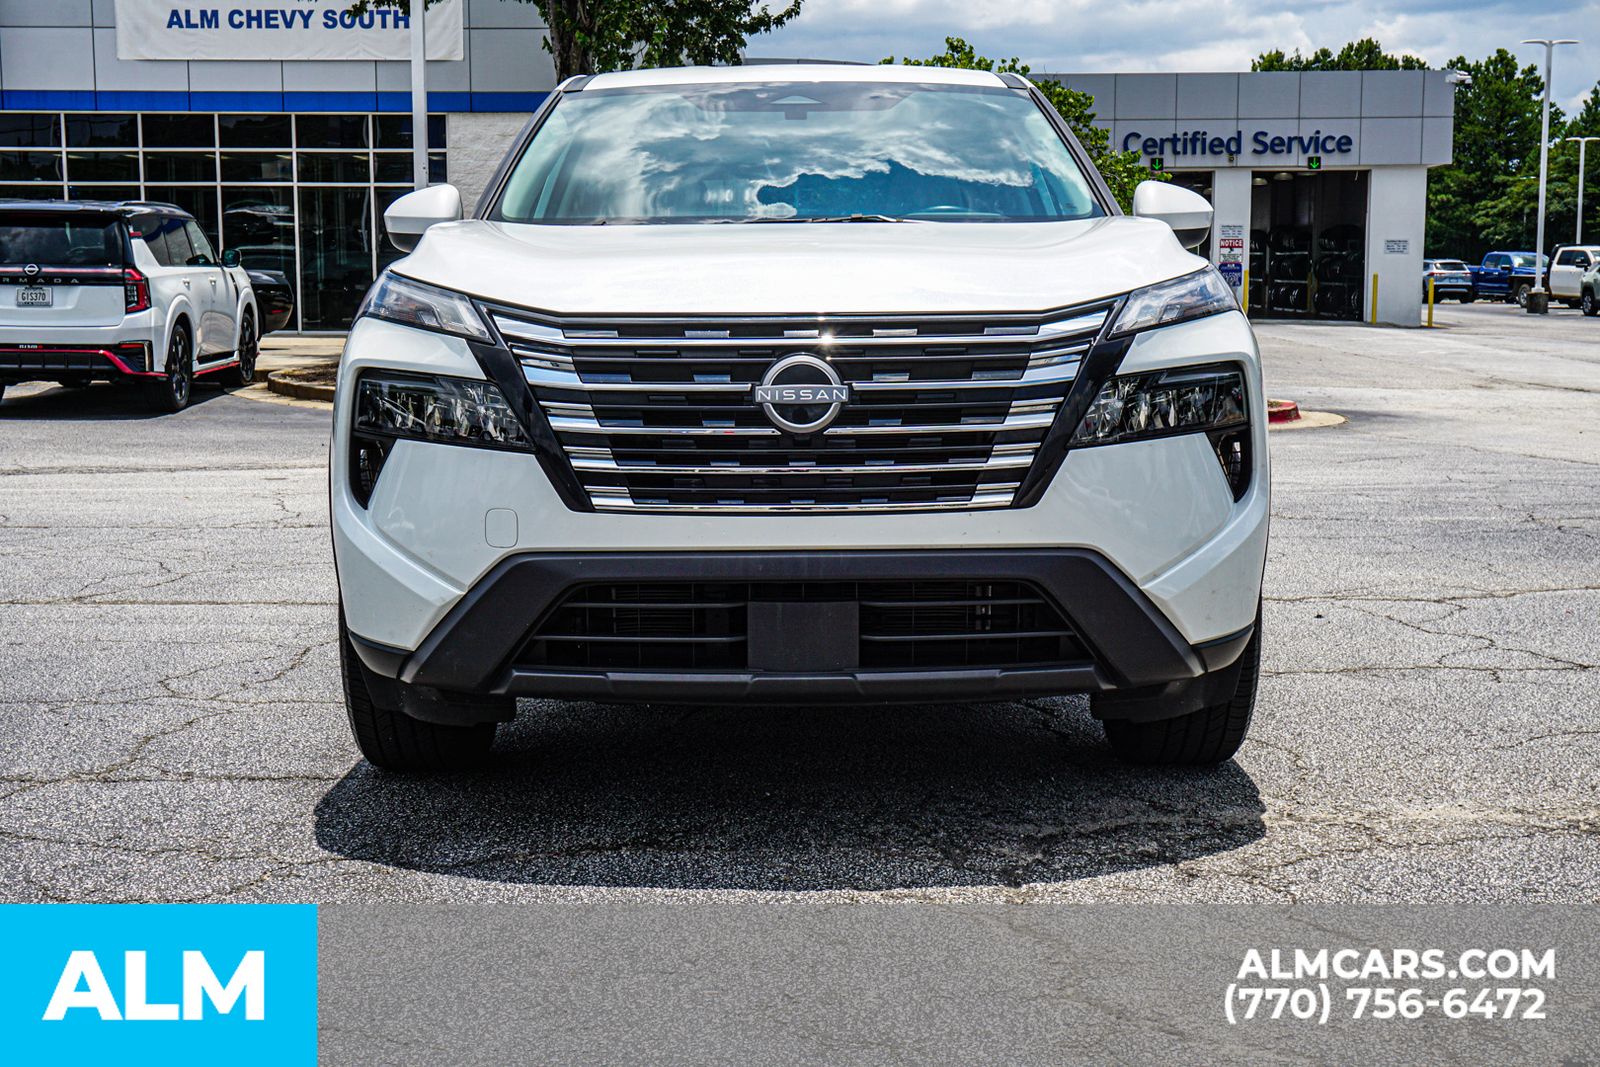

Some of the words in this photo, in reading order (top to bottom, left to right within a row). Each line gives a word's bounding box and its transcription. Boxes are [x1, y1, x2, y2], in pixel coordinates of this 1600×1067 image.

[166, 9, 220, 29] ALM
[227, 9, 315, 29] CHEVY
[322, 9, 411, 29] SOUTH
[1123, 130, 1242, 155] Certified
[1252, 130, 1353, 155] Service
[758, 389, 846, 401] NISSAN
